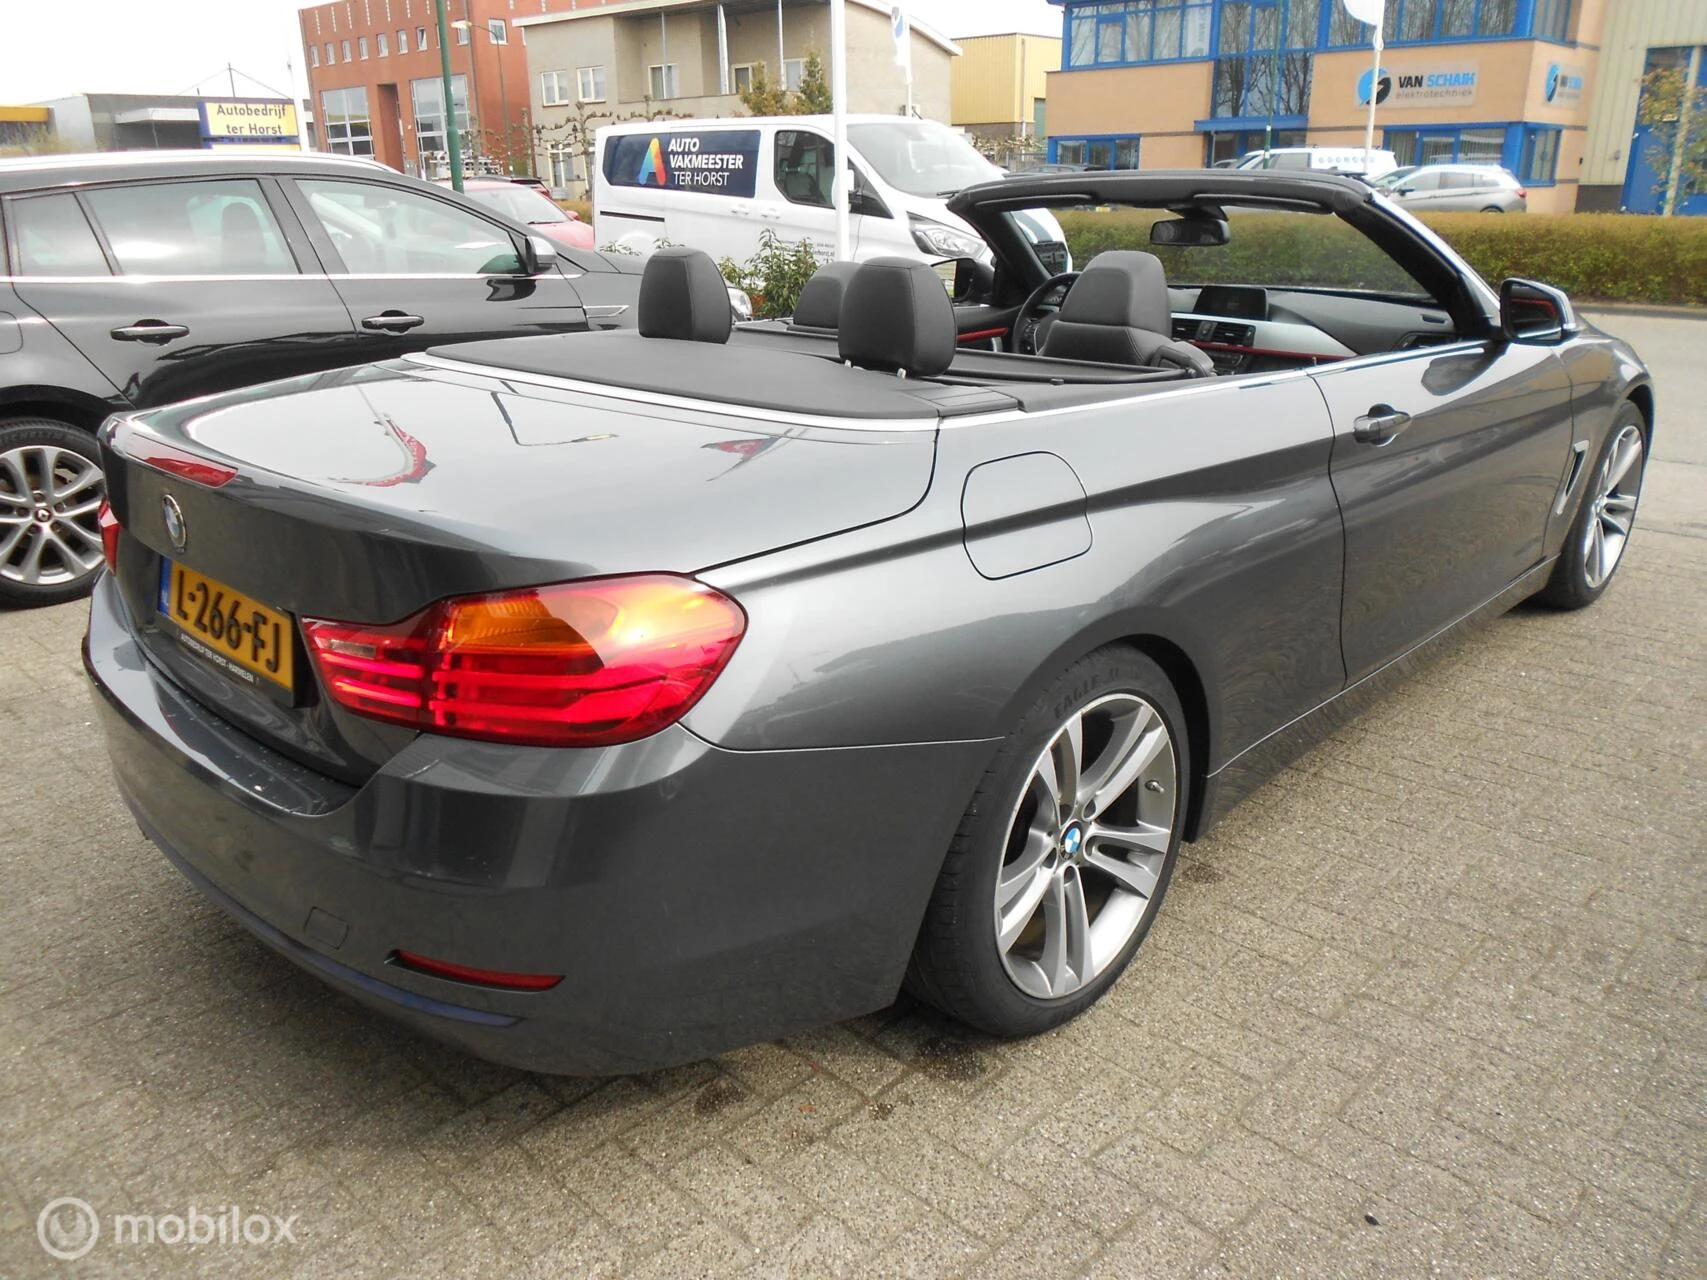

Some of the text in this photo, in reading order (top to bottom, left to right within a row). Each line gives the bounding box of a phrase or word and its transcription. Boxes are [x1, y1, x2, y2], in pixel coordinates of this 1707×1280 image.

[1398, 76, 1423, 88] VAN
[1396, 89, 1472, 99] elektrotechniek
[216, 103, 287, 119] Autobedrijf
[226, 123, 283, 135] ter Horst
[668, 138, 700, 152] AUTO
[670, 155, 744, 169] VAKMEESTER
[674, 172, 730, 186] TER HORST
[176, 569, 281, 674] L-266-FJ
